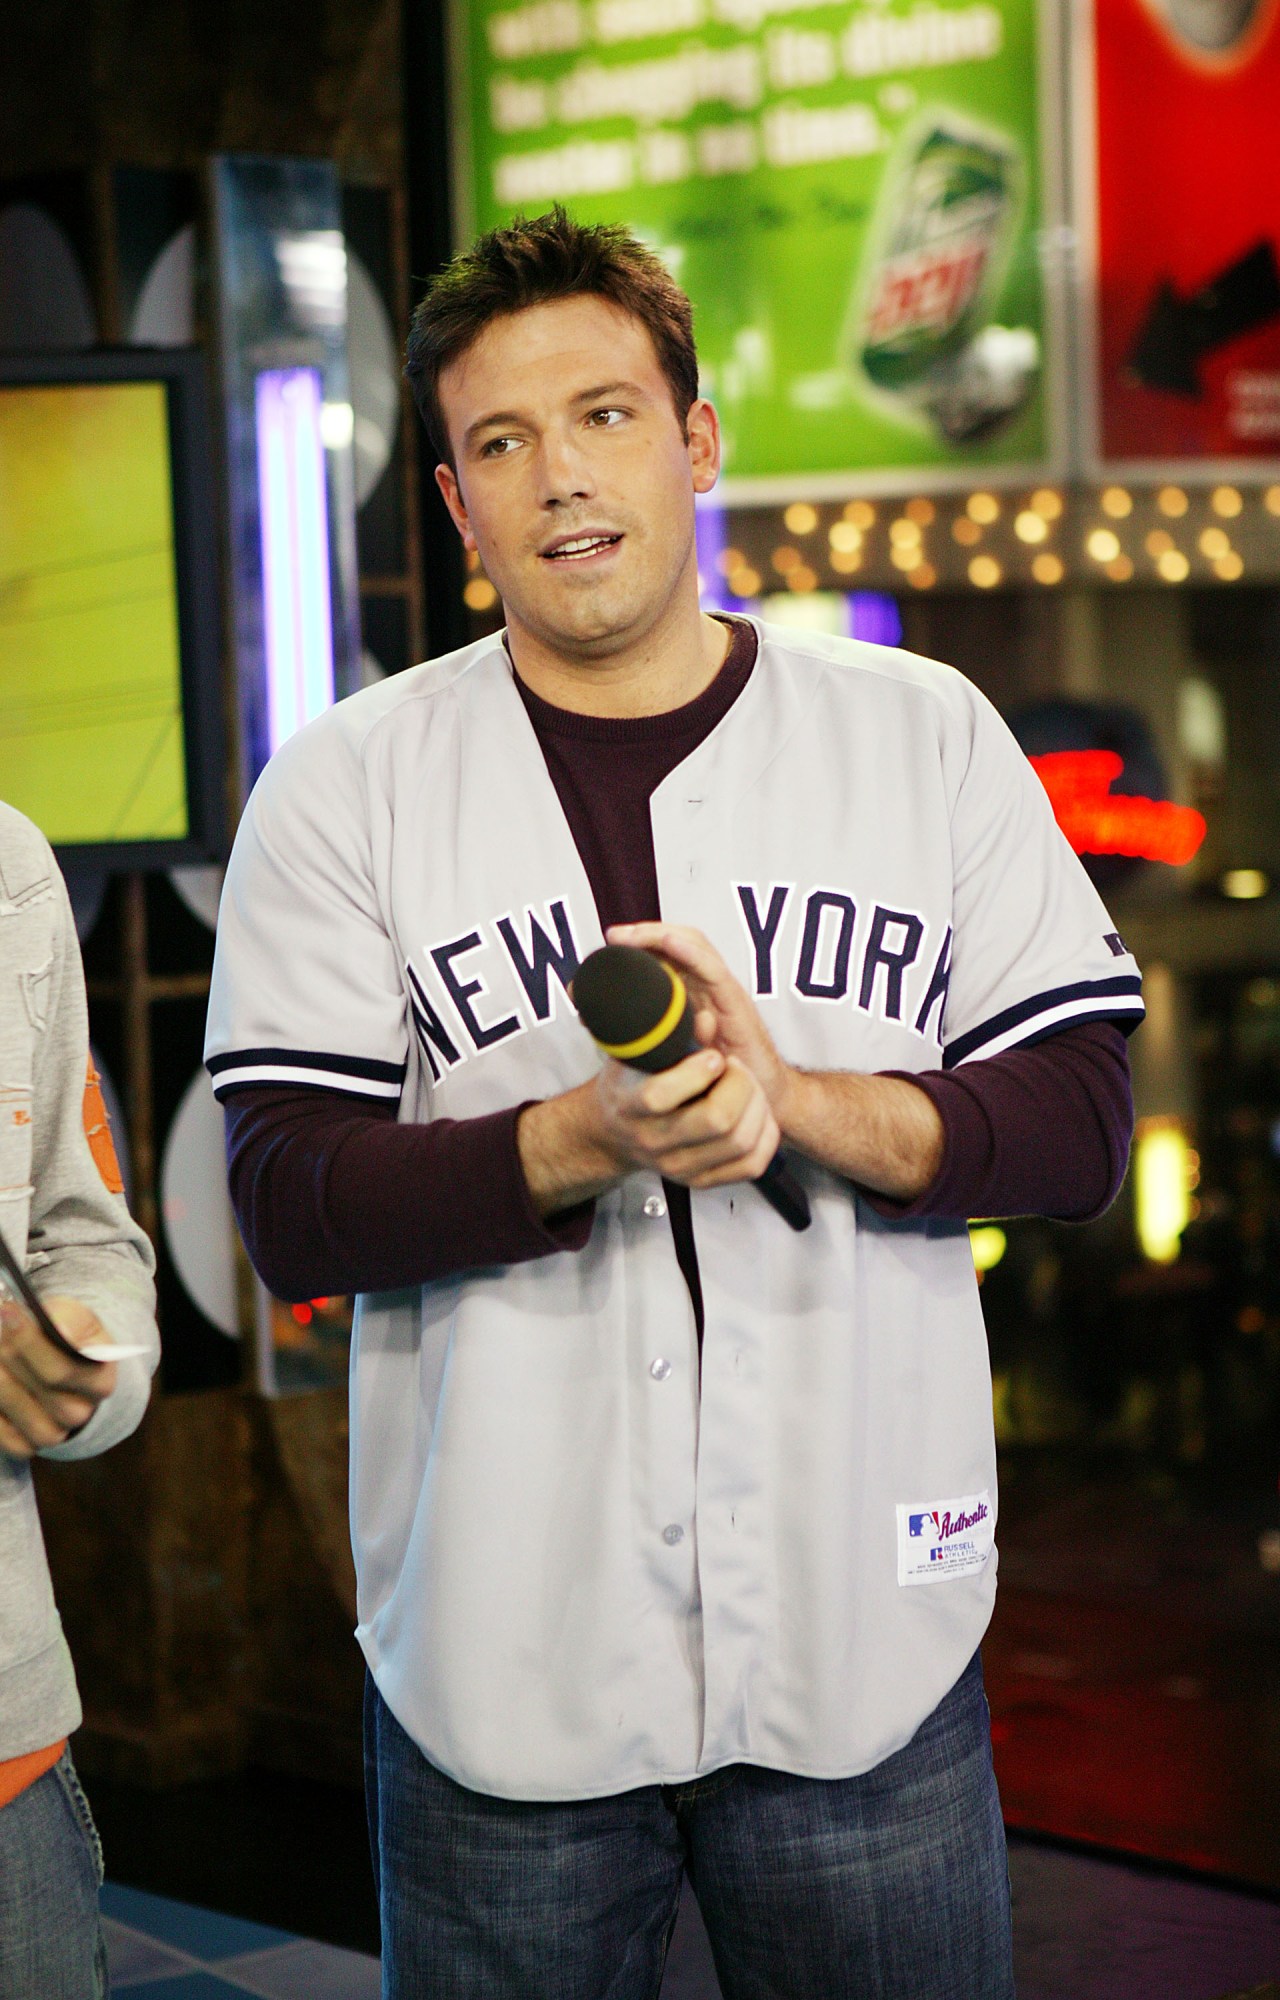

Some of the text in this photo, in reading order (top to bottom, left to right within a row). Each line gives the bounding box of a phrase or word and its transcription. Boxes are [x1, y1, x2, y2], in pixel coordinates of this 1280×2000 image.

[405, 880, 952, 1088] NEW YORK
[939, 1501, 988, 1541] Authentic
[944, 1541, 975, 1551] RUSSELL
